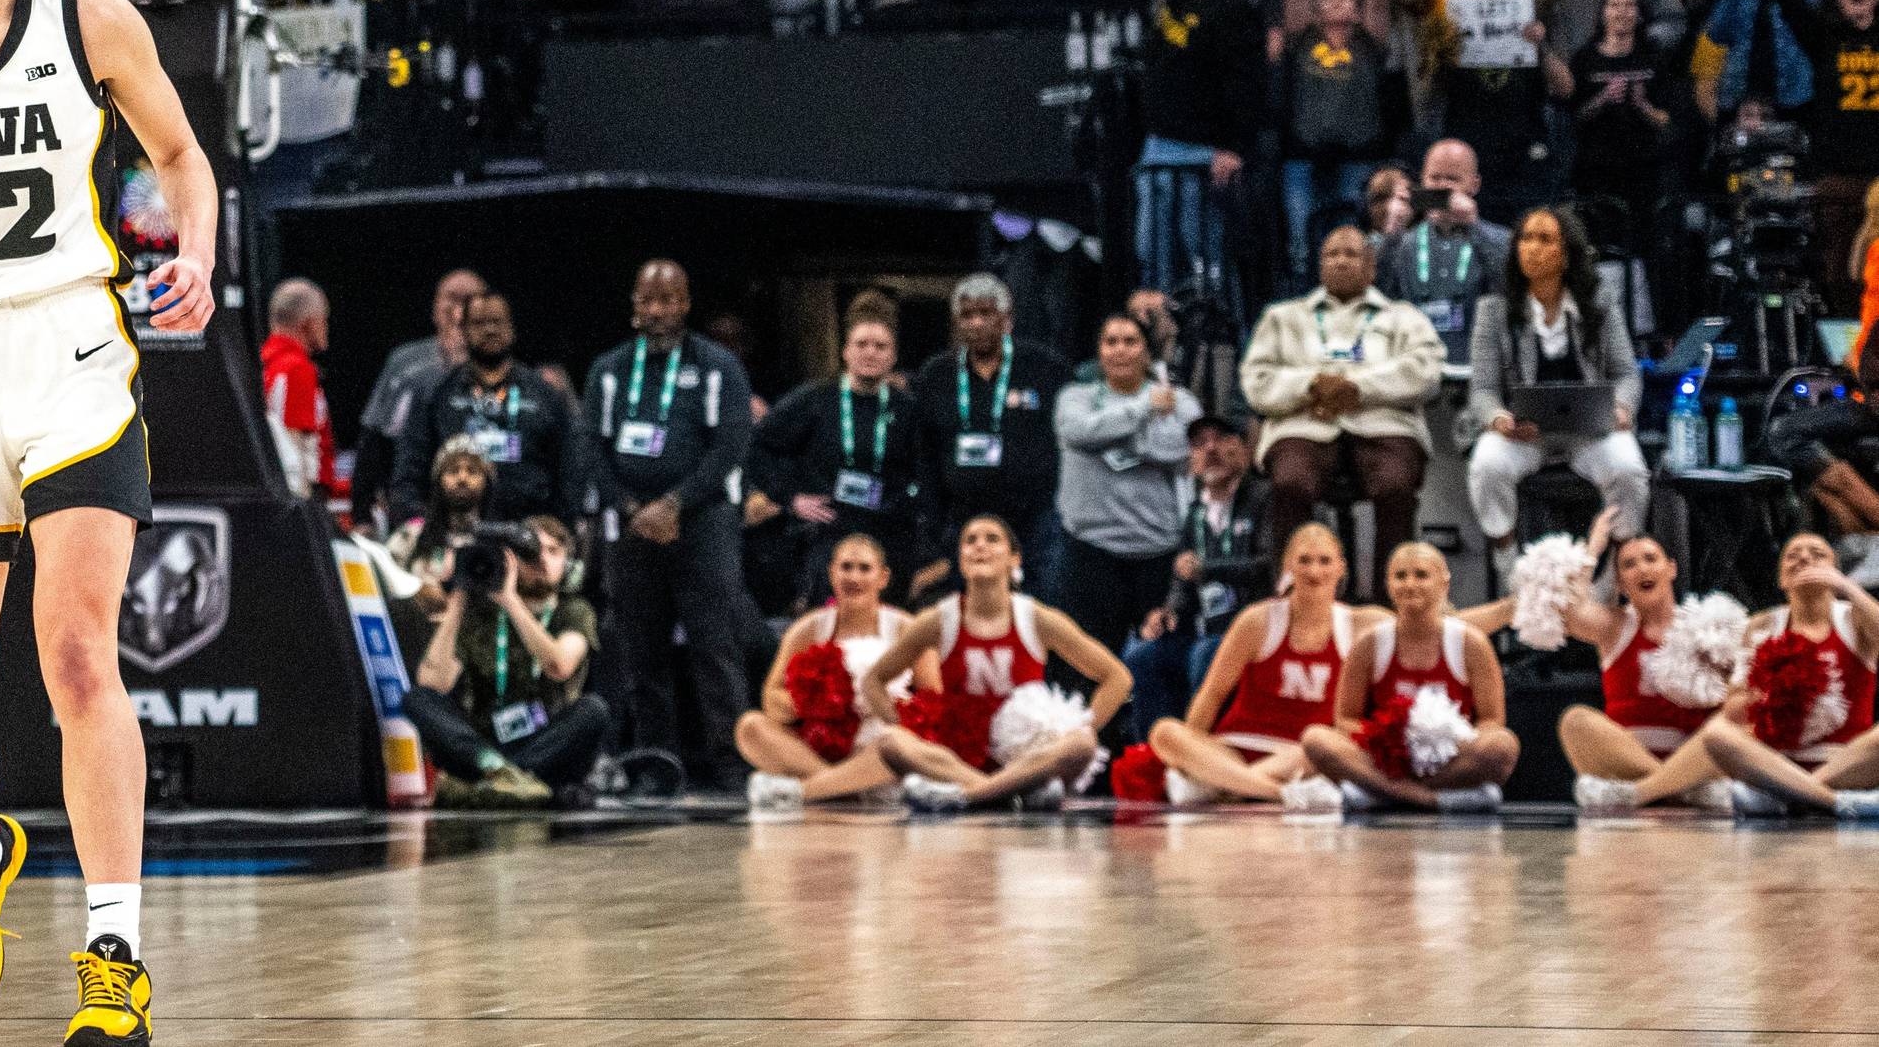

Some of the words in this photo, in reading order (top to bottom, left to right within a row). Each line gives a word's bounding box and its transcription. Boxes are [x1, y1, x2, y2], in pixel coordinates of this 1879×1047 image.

[964, 646, 1014, 697] N
[1278, 659, 1332, 703] N
[51, 688, 259, 726] AM
